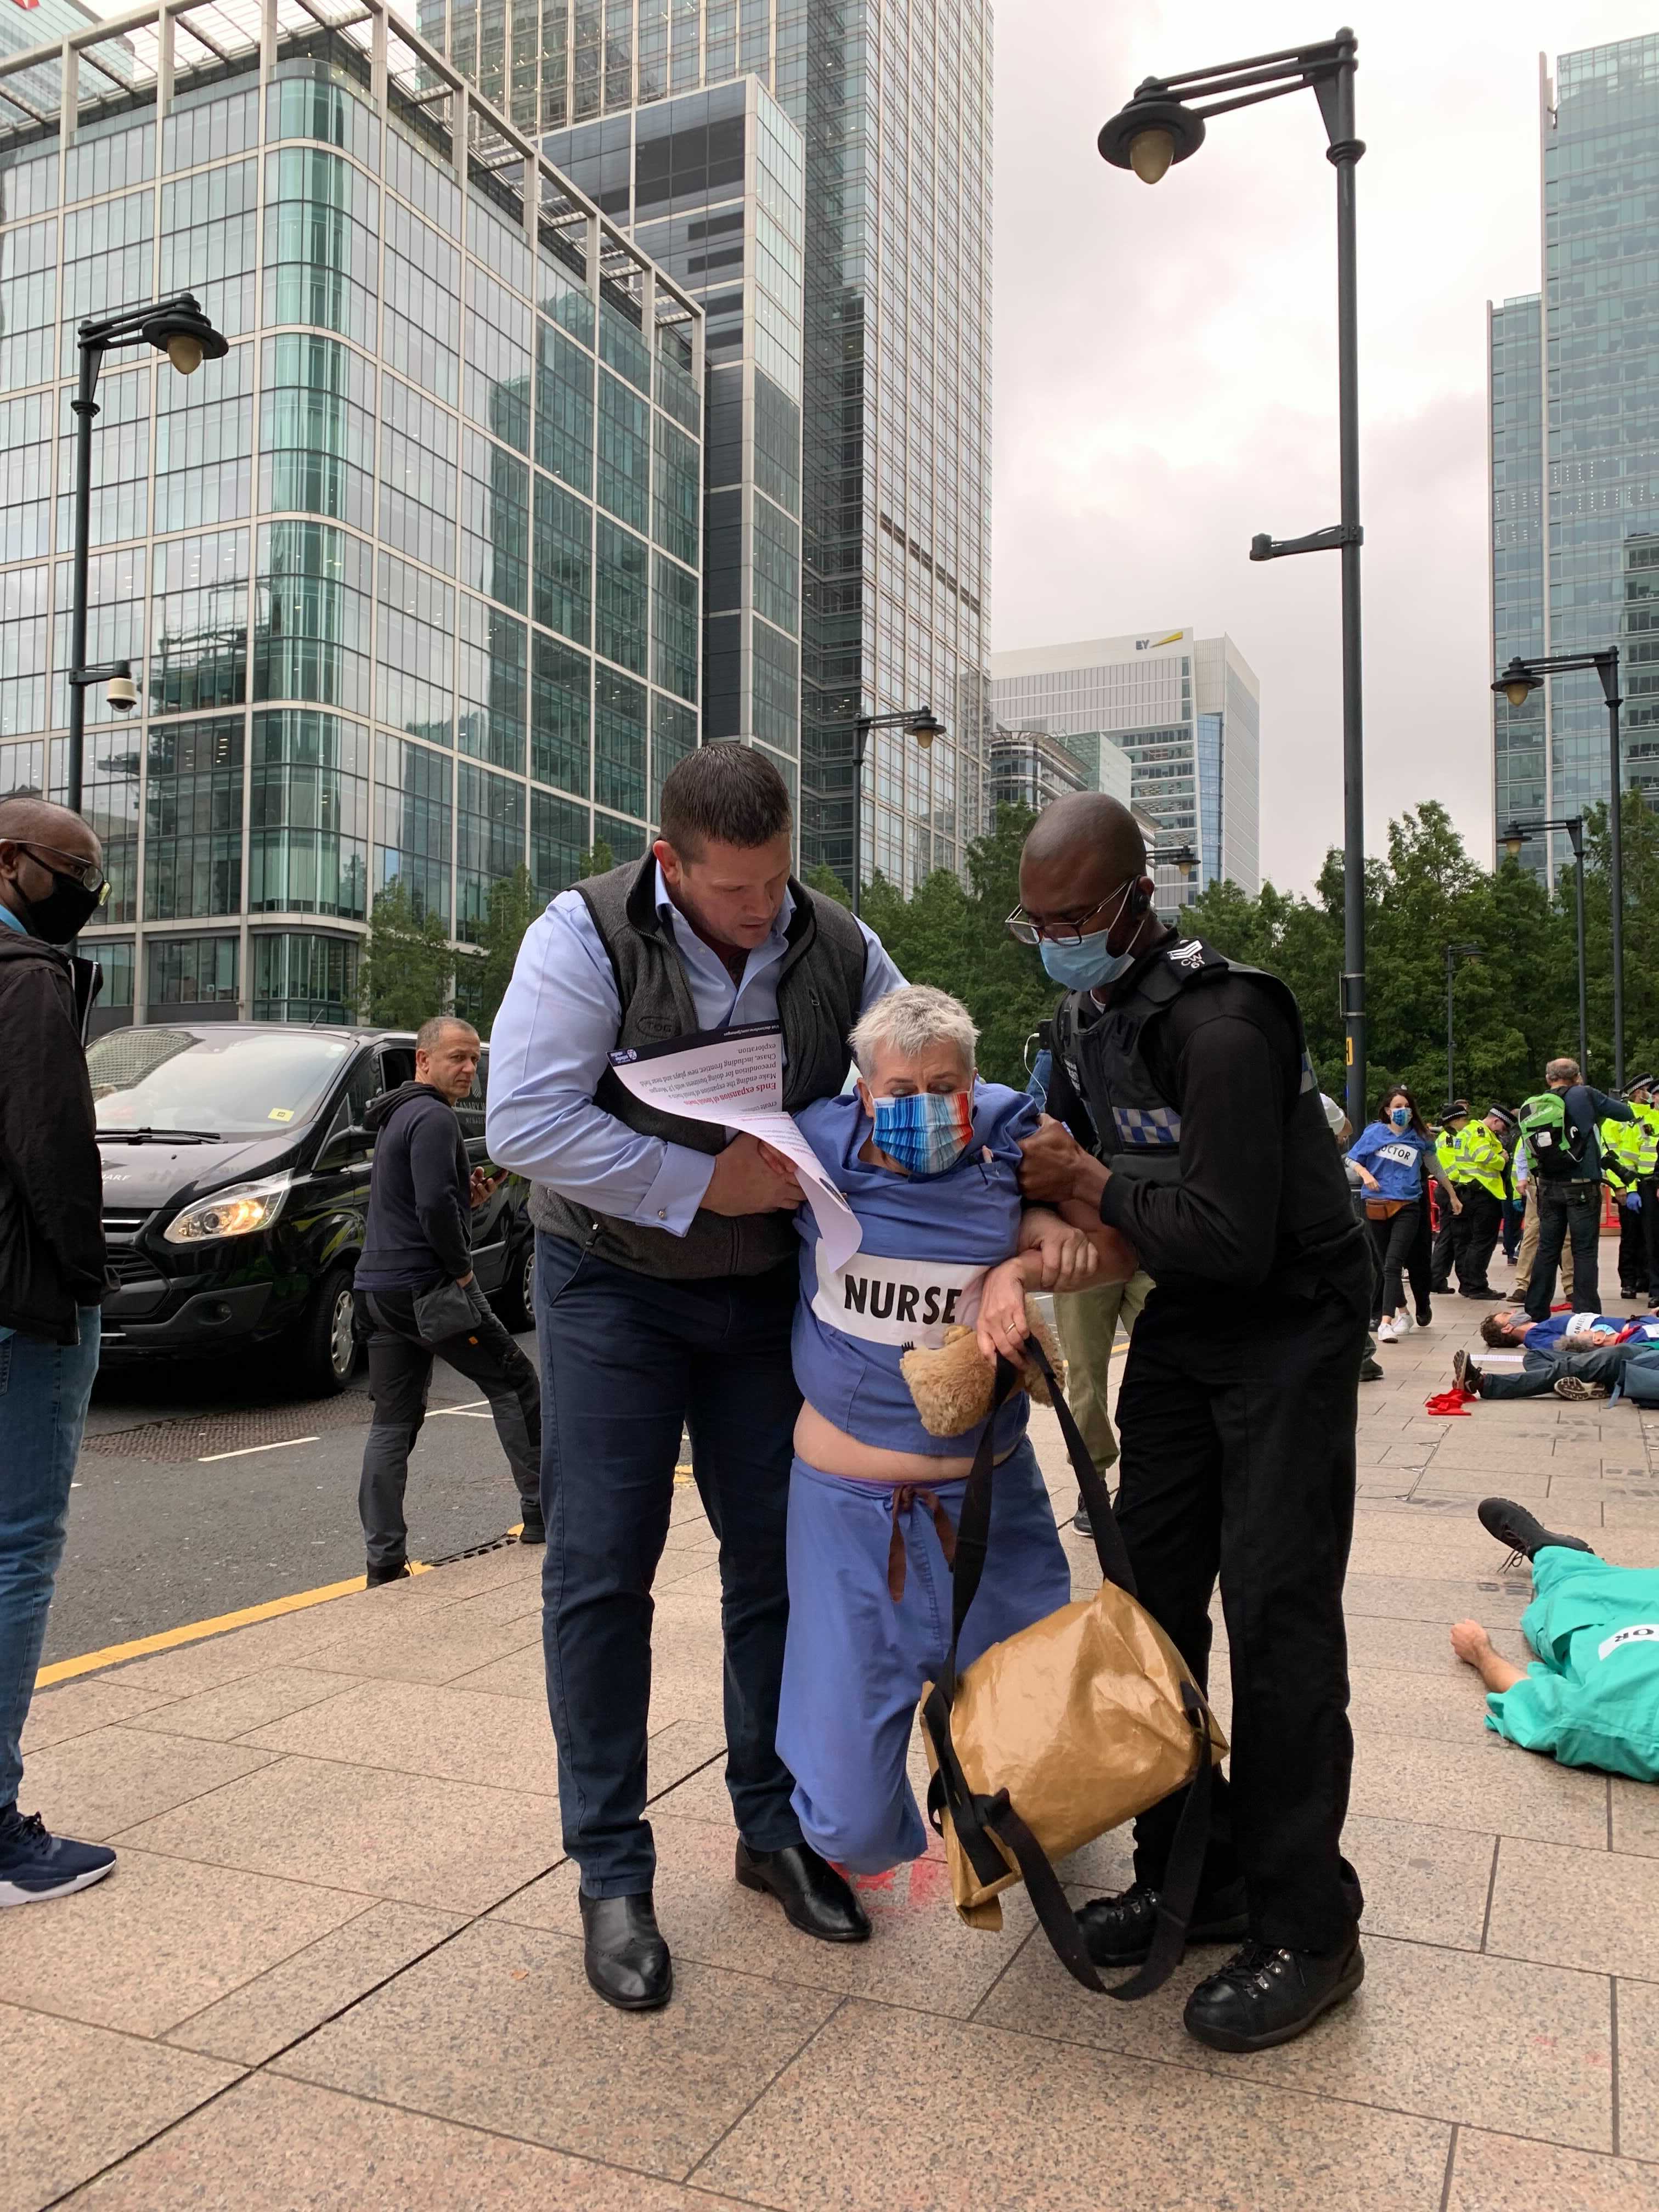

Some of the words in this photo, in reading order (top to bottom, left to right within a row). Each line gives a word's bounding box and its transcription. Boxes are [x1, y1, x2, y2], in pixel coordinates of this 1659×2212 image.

[1136, 640, 1150, 650] EY
[724, 1057, 753, 1067] including
[755, 1053, 776, 1062] Chase,
[687, 1069, 698, 1077] new
[699, 1063, 723, 1074] frontier,
[735, 1062, 776, 1075] precondition
[663, 1075, 672, 1083] and
[673, 1071, 686, 1079] plays
[707, 1073, 724, 1082] doing
[686, 1077, 707, 1088] business
[737, 1076, 757, 1085] ending
[700, 1084, 725, 1095] expansion
[756, 1082, 776, 1092] Ends
[720, 1087, 754, 1102] expansion
[455, 1101, 480, 1111] CANARY
[760, 1102, 777, 1110] create
[1378, 1144, 1410, 1160] OCTOR
[844, 1274, 962, 1325] NURSE
